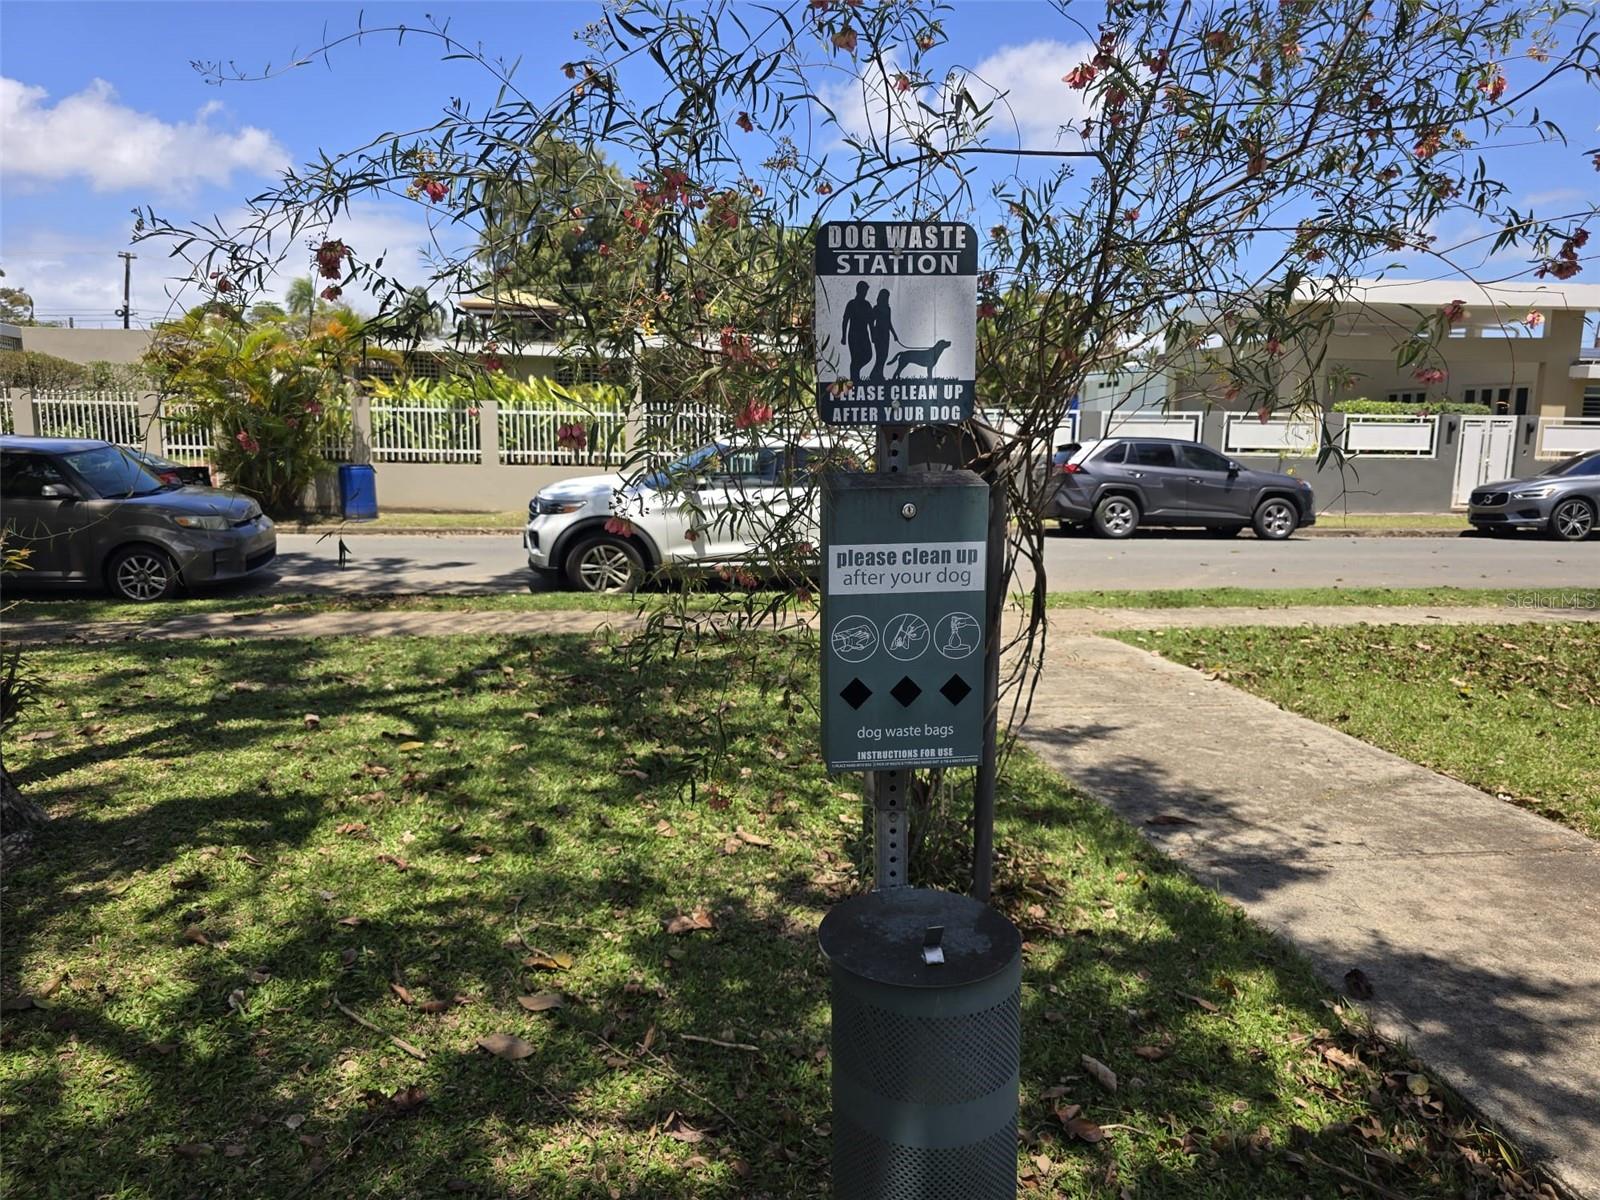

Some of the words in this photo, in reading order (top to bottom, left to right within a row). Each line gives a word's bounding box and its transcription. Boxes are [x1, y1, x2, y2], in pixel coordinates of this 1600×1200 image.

[828, 225, 876, 248] DOG
[886, 225, 966, 248] WASTE
[836, 254, 958, 274] STATION
[890, 385, 938, 400] CLEAN
[944, 385, 964, 400] UP
[832, 407, 878, 422] AFTER
[884, 406, 924, 421] YOUR
[930, 406, 960, 420] DOG
[836, 550, 896, 568] please
[902, 548, 950, 565] clean
[956, 549, 978, 565] up
[843, 569, 885, 586] after
[890, 571, 932, 588] your
[936, 567, 971, 586] dog
[857, 726, 882, 740] dog
[886, 726, 922, 737] waste
[924, 724, 954, 738] bags
[858, 749, 918, 760] INSTRUCTIONS
[920, 748, 936, 758] FOR
[938, 748, 953, 756] USE
